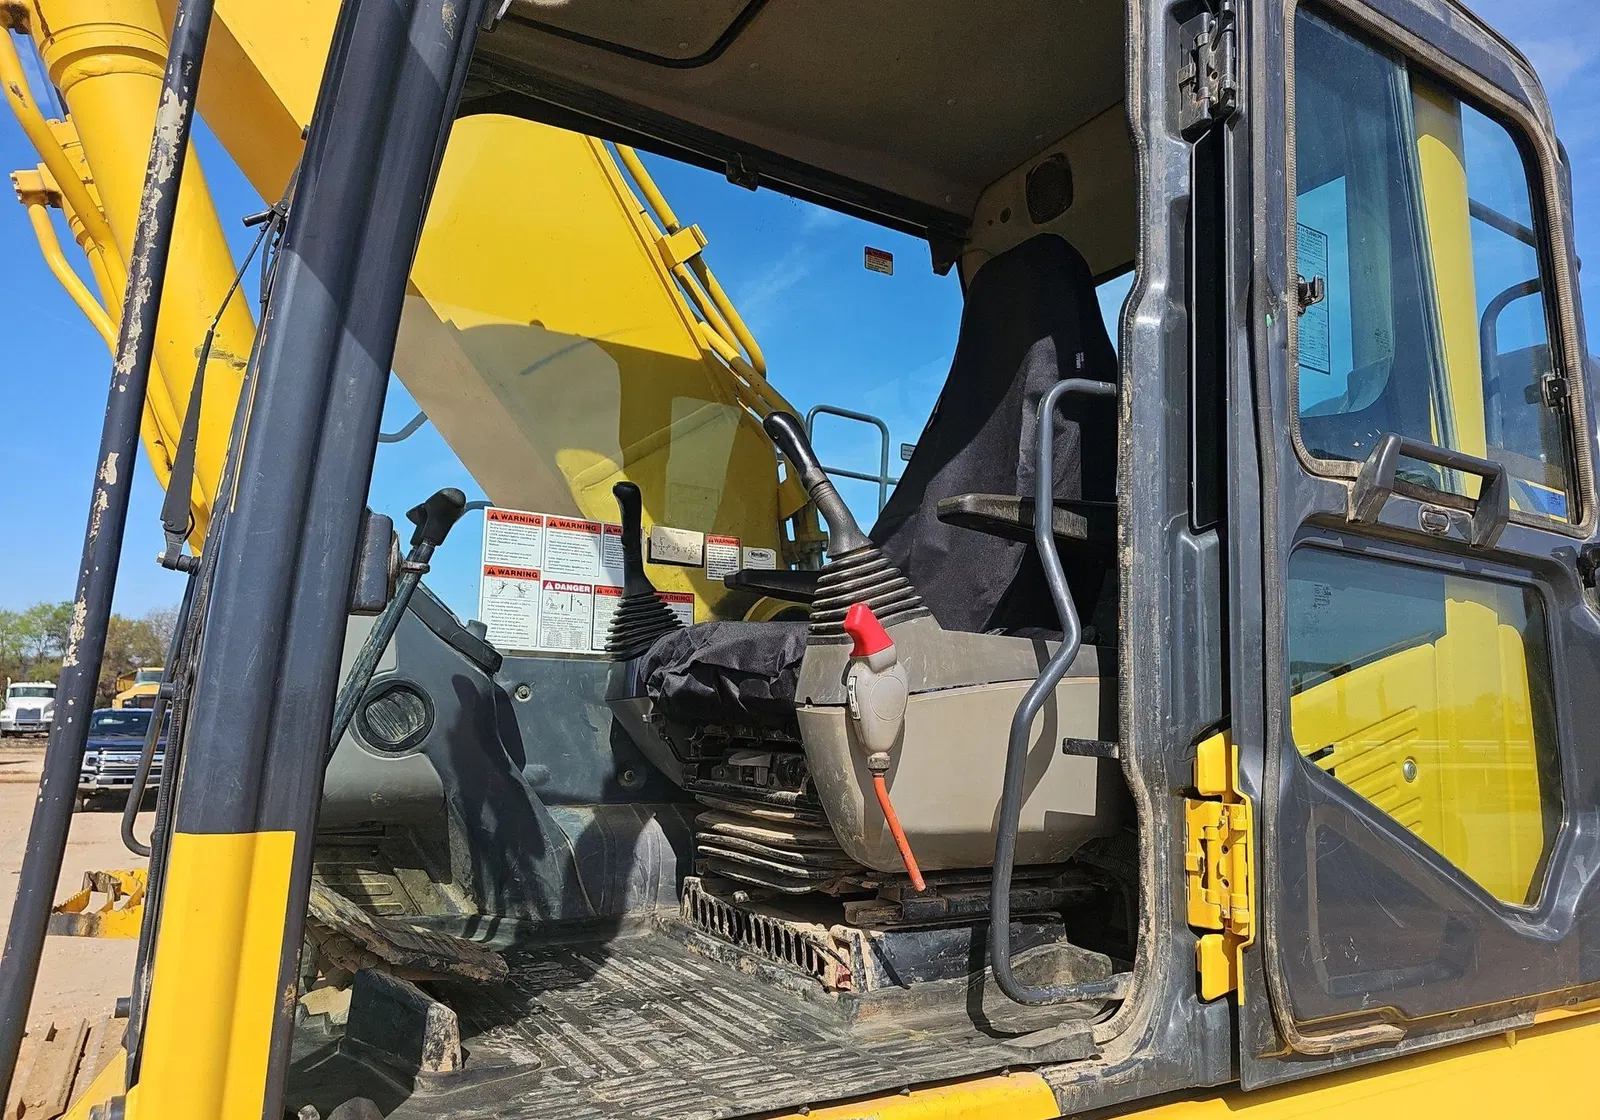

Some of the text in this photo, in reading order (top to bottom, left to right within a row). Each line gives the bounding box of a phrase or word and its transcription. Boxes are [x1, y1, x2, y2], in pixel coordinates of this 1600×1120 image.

[501, 514, 540, 524] WARNING
[559, 521, 596, 531] WARNING
[498, 569, 537, 578] WARNING
[555, 583, 590, 592] DANGER
